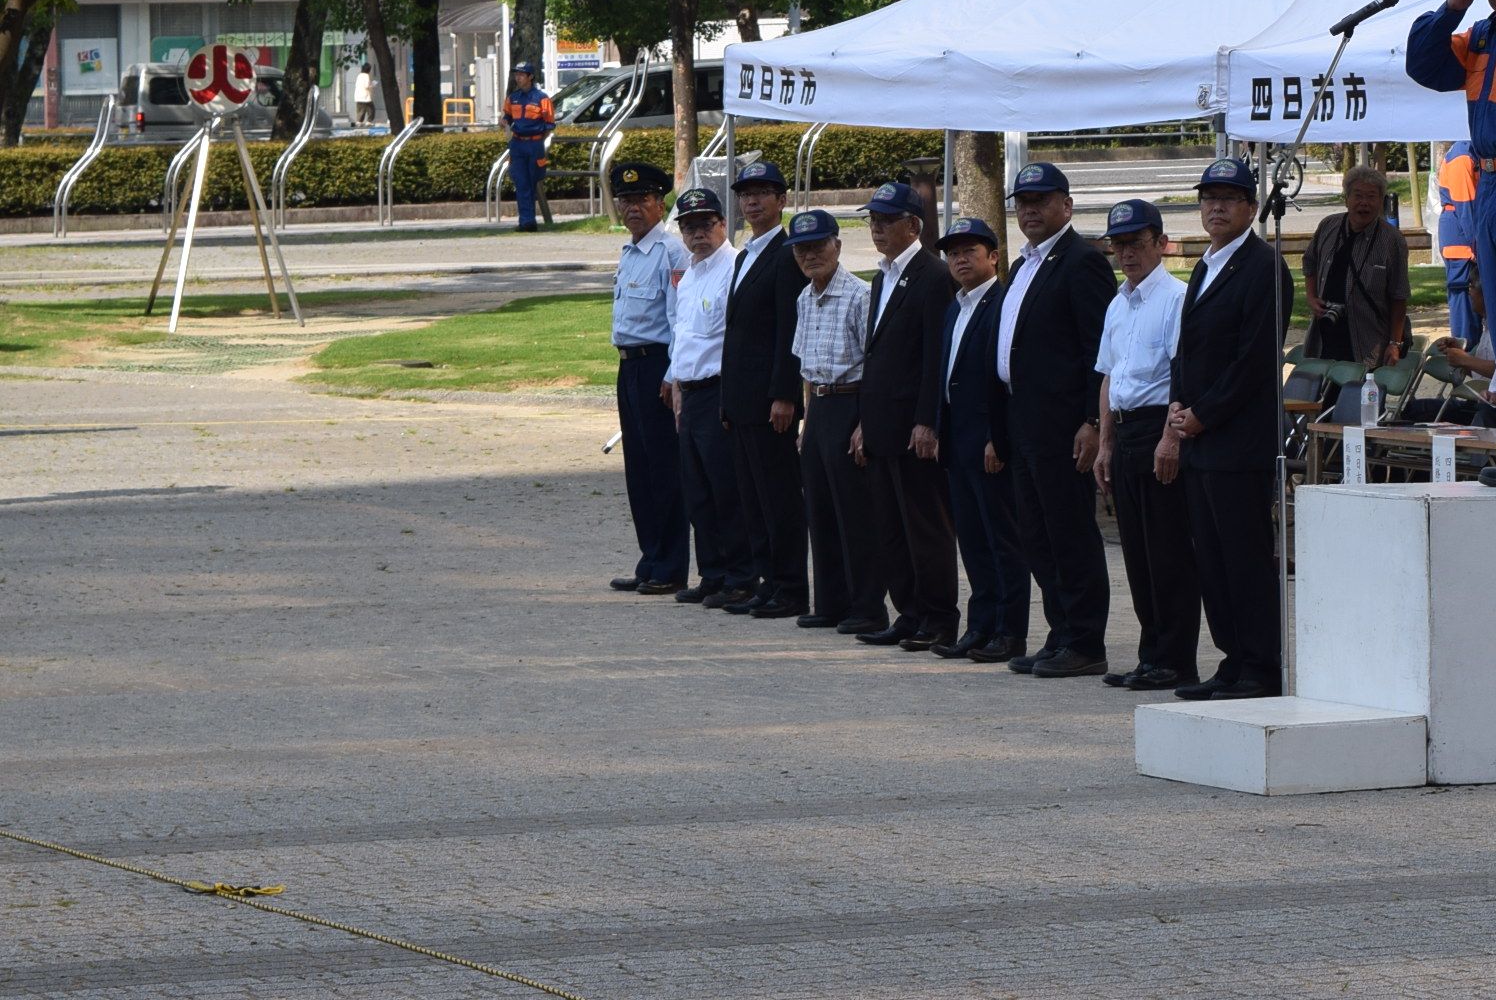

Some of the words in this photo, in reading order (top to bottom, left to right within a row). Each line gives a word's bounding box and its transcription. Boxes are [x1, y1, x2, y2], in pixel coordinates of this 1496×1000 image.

[738, 63, 817, 106] 四日市市
[1250, 72, 1368, 122] 四日市市
